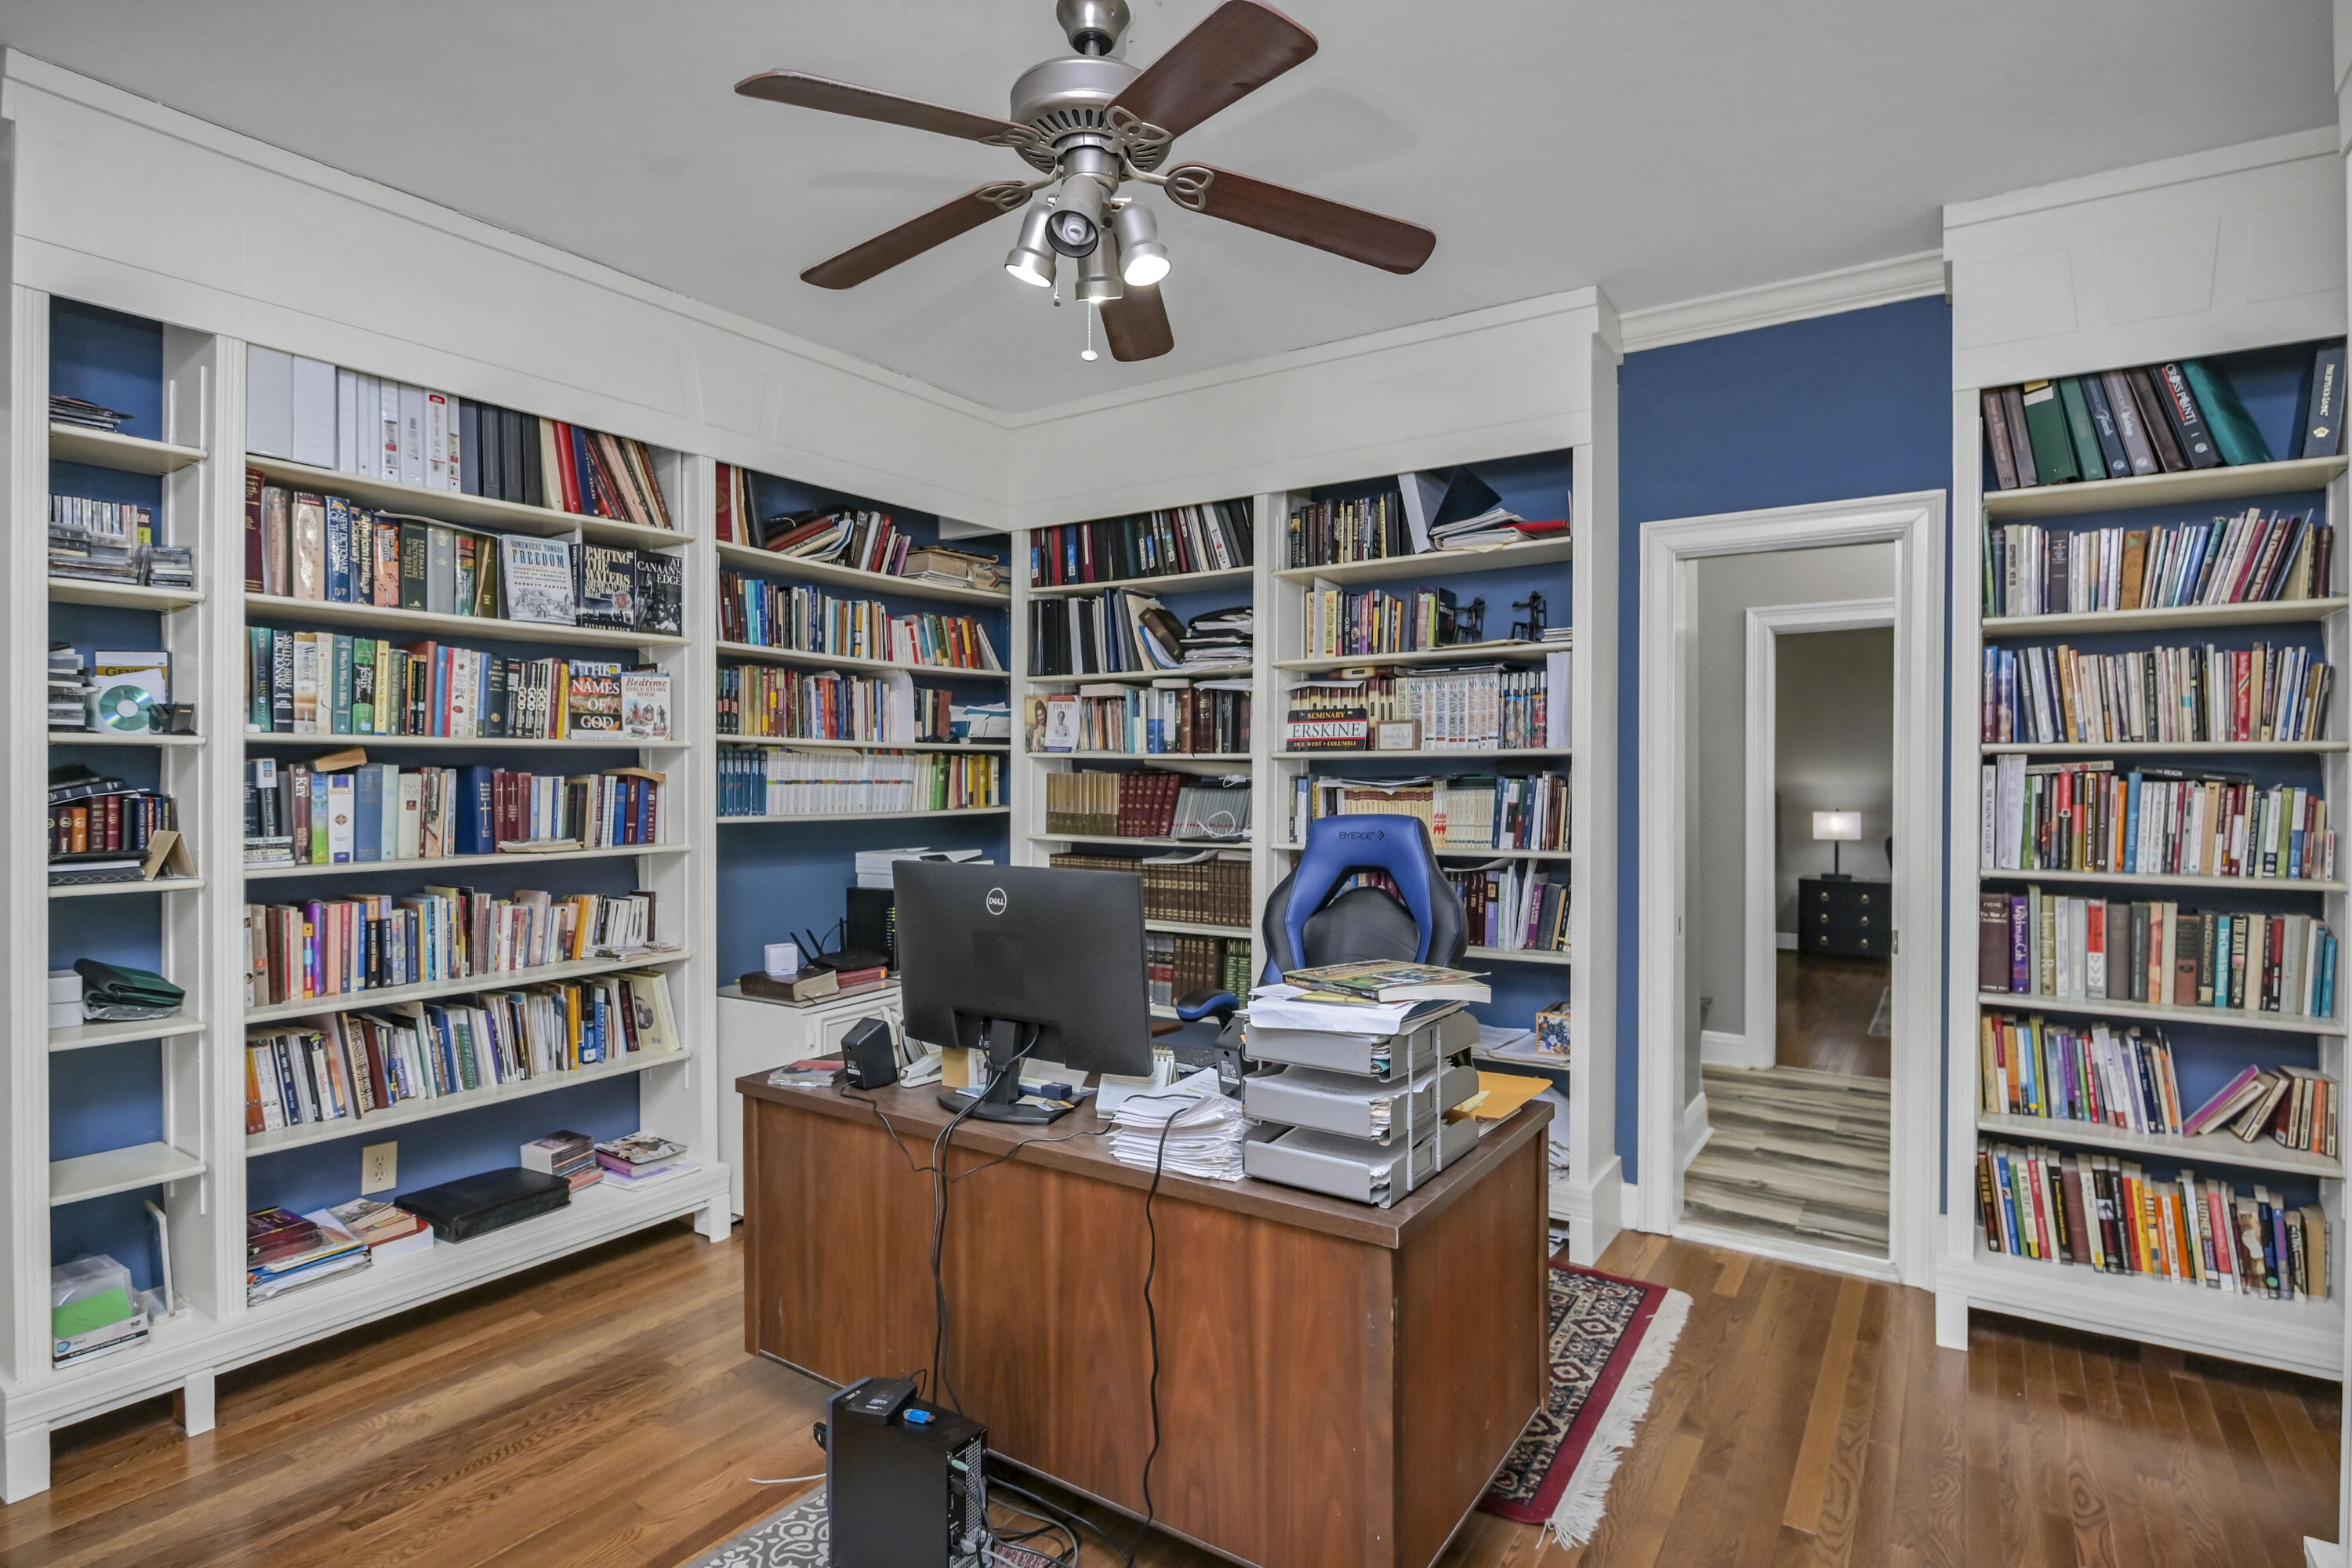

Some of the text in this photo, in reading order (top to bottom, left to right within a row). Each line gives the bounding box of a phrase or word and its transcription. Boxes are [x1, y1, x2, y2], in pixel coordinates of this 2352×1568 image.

[329, 510, 339, 524] OF
[339, 512, 348, 575] NEW DICTIONARY
[350, 520, 361, 564] Dictionary
[510, 540, 564, 554] SOMEWHERE TOWARD
[359, 516, 371, 594] American Heritage
[511, 549, 564, 568] FREEDOM
[584, 546, 630, 564] PARTING
[670, 557, 681, 567] AT
[404, 555, 412, 579] BIBLE
[585, 557, 609, 573] THE
[637, 561, 681, 576] CANAAN'S
[584, 568, 630, 586] WATERS
[656, 574, 681, 586] EDGE
[275, 636, 285, 690] DICTIONARY
[283, 634, 293, 690] SMITH'S BIBLE
[339, 651, 348, 668] Who's
[339, 670, 348, 684] Who
[583, 664, 611, 677] THE
[257, 680, 267, 697] MAN
[572, 679, 620, 695] NAMES
[626, 677, 666, 687] Bedtime
[517, 687, 527, 710] GOD
[527, 687, 537, 711] GOD
[537, 688, 546, 711] GOD
[588, 699, 607, 711] OF
[580, 715, 614, 729] GOD
[1307, 711, 1346, 720] SEMINARY
[1291, 722, 1362, 739] ERSKINE
[295, 776, 307, 797] KEY
[1338, 831, 1374, 840] EMERGE
[989, 897, 1004, 906] DELL
[2219, 927, 2230, 940] The
[2196, 1199, 2212, 1237] LUTHER
